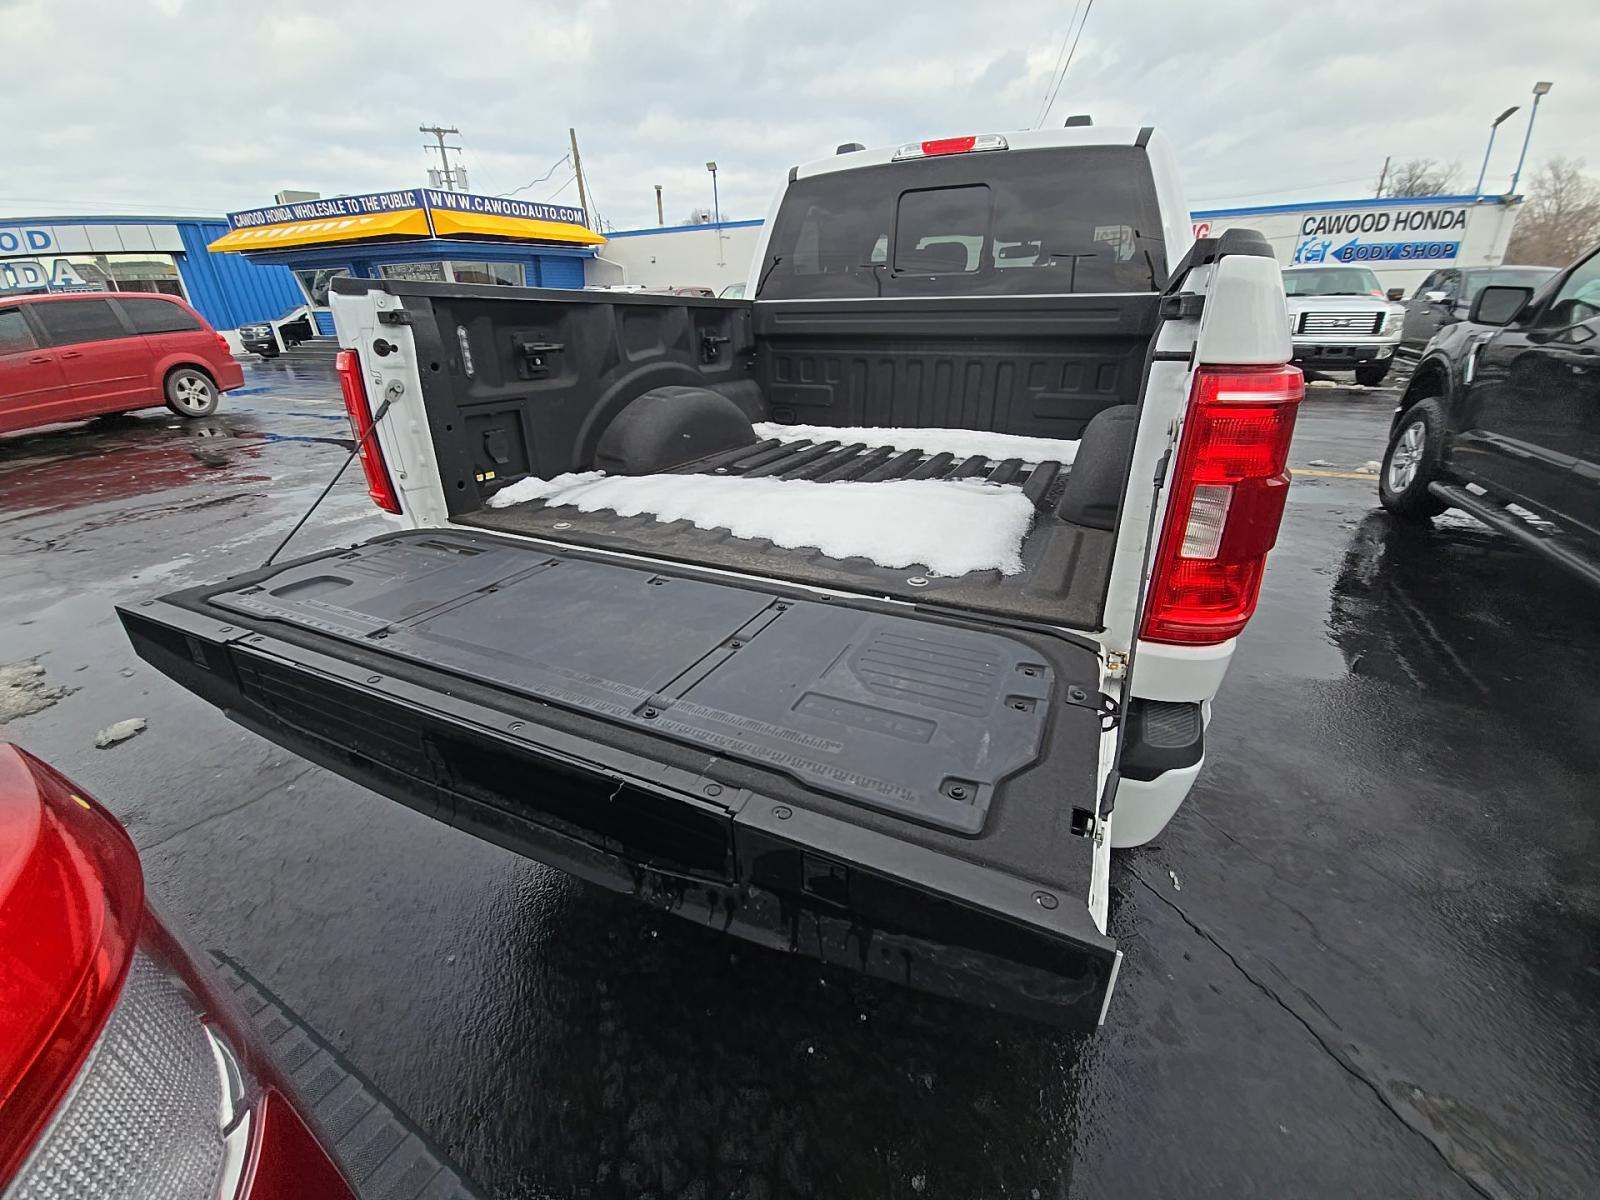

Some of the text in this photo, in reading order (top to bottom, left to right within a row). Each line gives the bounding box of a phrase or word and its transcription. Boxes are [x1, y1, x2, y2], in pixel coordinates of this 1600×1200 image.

[234, 192, 416, 227] CAWOOD HONDA WHOLESALE TO THE PUBLIC
[428, 191, 583, 223] WWW.CAWOODAUTO.COM
[1302, 209, 1467, 236] CAWOOD HONDA
[1342, 243, 1455, 261] BODY SHOP
